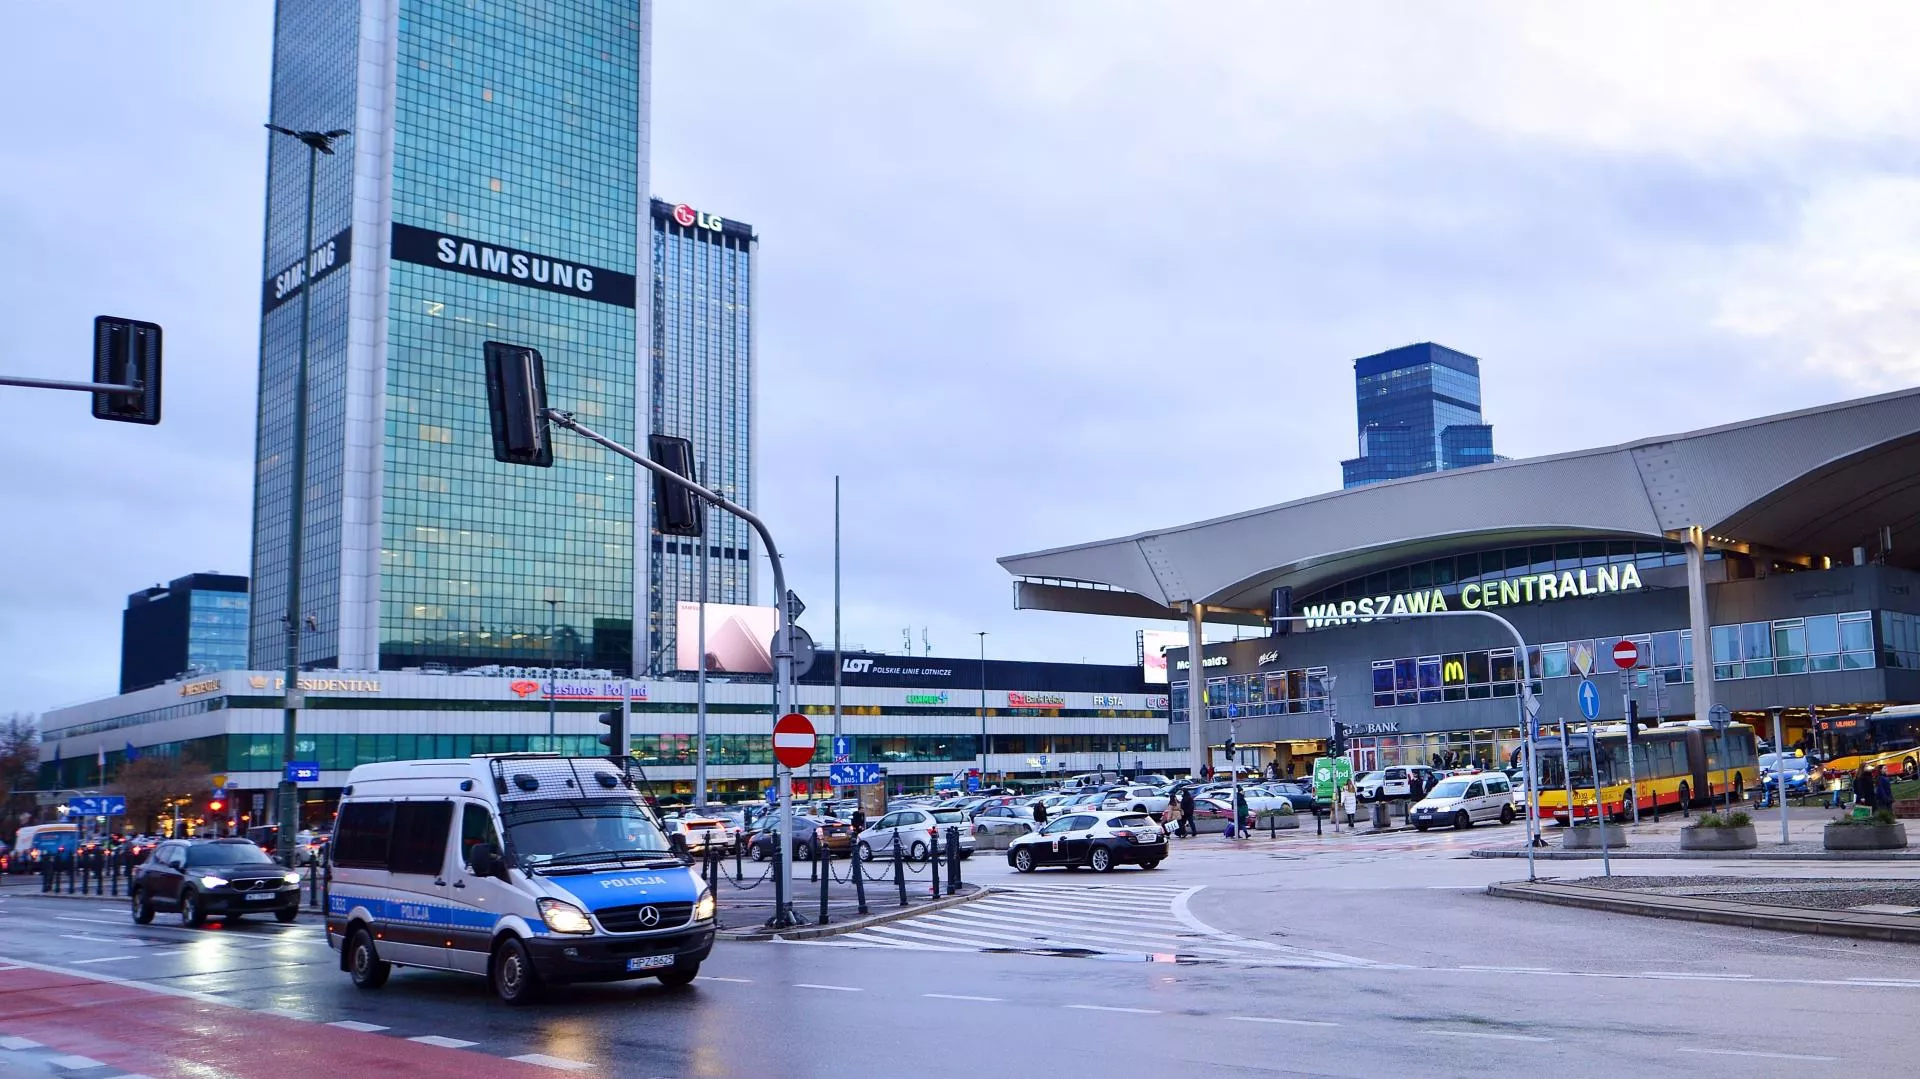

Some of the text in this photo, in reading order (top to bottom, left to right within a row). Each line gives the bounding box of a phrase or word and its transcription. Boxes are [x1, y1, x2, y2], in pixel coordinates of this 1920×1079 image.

[697, 211, 723, 232] LG
[437, 237, 593, 292] SAMSUNG
[1303, 563, 1642, 628] WARSZAWA CENTRALNA
[842, 659, 873, 673] LOT
[872, 667, 900, 675] POLSKIE
[921, 668, 952, 676] LOTNICZE
[1177, 656, 1228, 670] Mcnald's
[274, 678, 381, 692] PESIDENTIAL
[543, 682, 648, 696] Casinos Polnd
[1368, 722, 1399, 738] BANK
[600, 876, 666, 889] POLICJA
[401, 904, 430, 920] POLICJA
